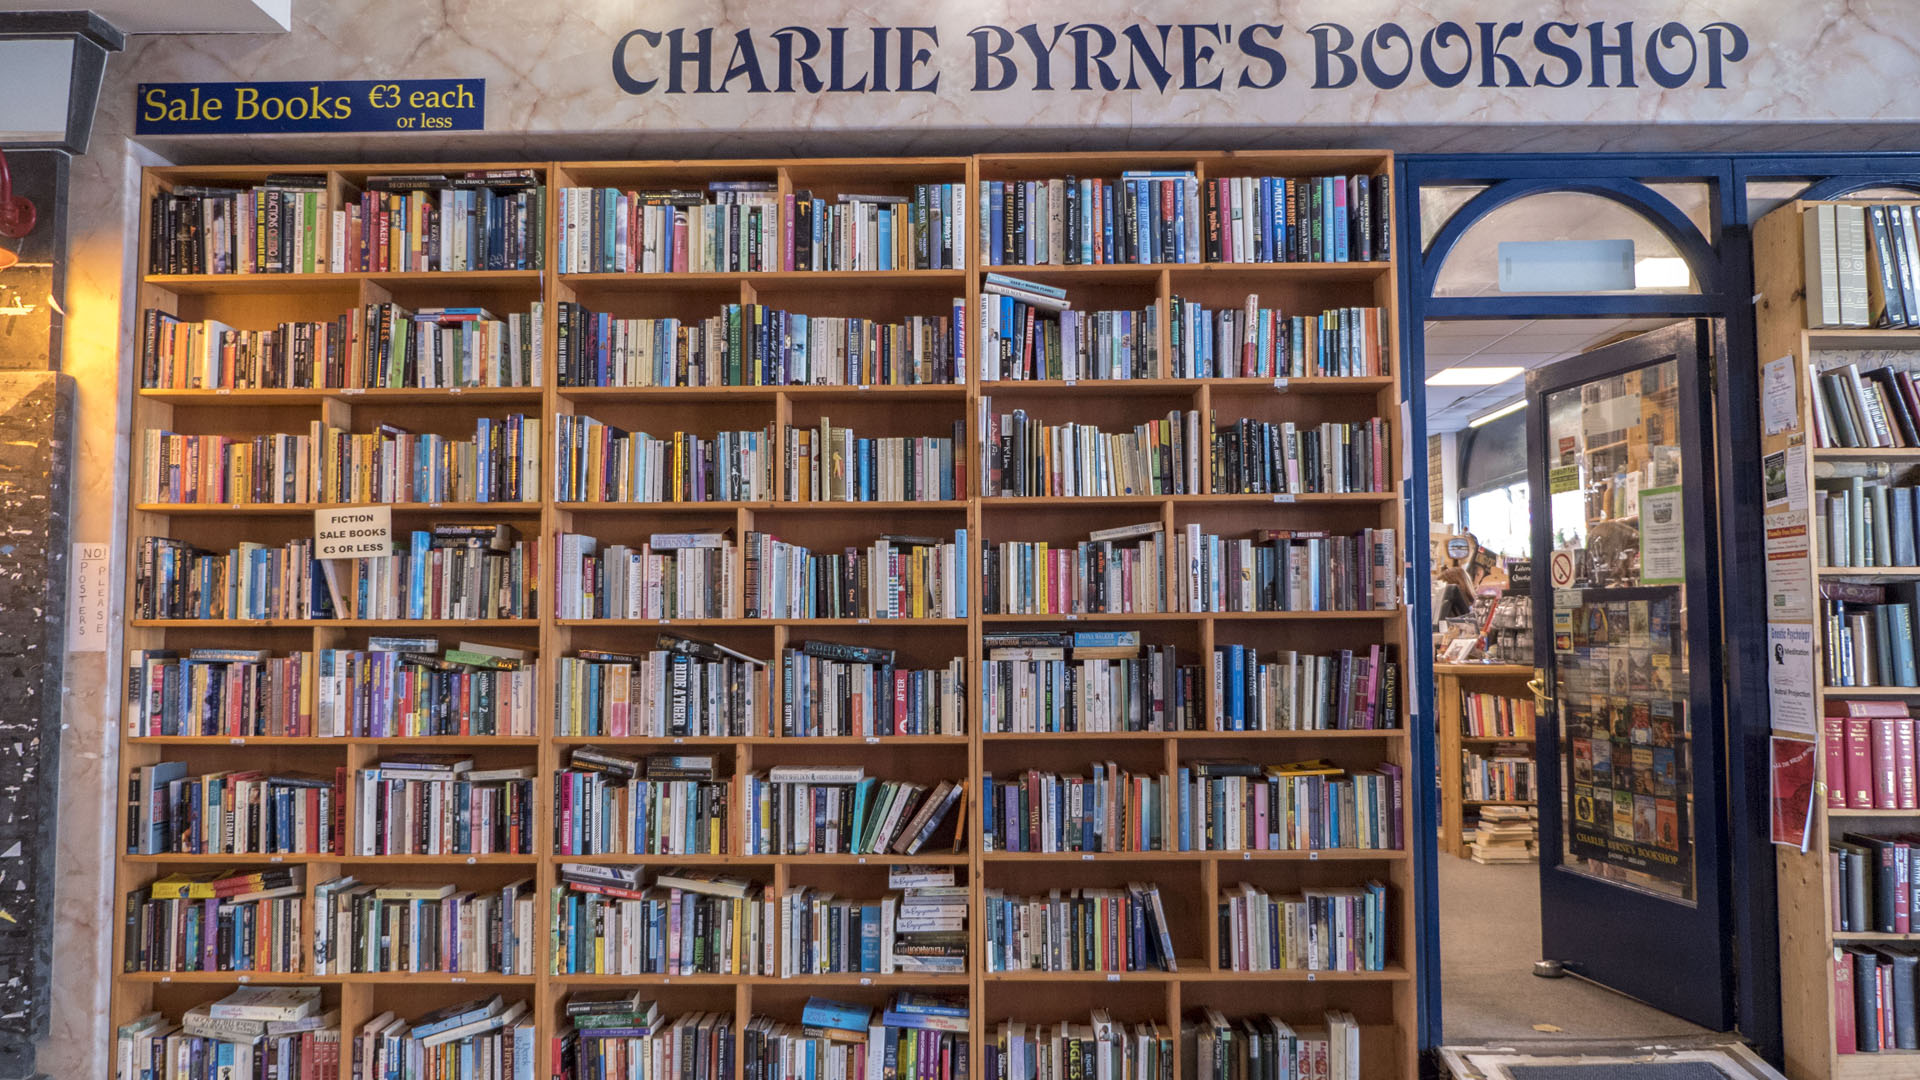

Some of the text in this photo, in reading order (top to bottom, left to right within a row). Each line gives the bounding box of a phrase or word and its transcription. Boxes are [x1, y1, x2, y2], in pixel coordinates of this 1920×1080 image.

[613, 22, 1750, 96] CHARLIE BYRNE'S BOOKSHOP
[145, 87, 353, 122] Sale Books
[369, 84, 476, 111] €3 each
[397, 114, 453, 130] or less
[1275, 187, 1284, 225] MIRACLE
[380, 215, 388, 244] TAKEN
[381, 310, 390, 341] PYRES
[331, 514, 375, 525] FICTION
[319, 528, 388, 541] SALE BOOKS
[84, 548, 107, 559] NO!
[322, 543, 385, 556] €3 OR LESS
[673, 663, 687, 726] RIDE A TIGER
[897, 679, 905, 701] AFTER
[225, 811, 233, 846] TELEMARK
[1576, 833, 1605, 847] CHARLIE
[1637, 847, 1679, 865] BOOKSHOP
[522, 1043, 530, 1065] Derek
[684, 1034, 692, 1072] DECEIVED
